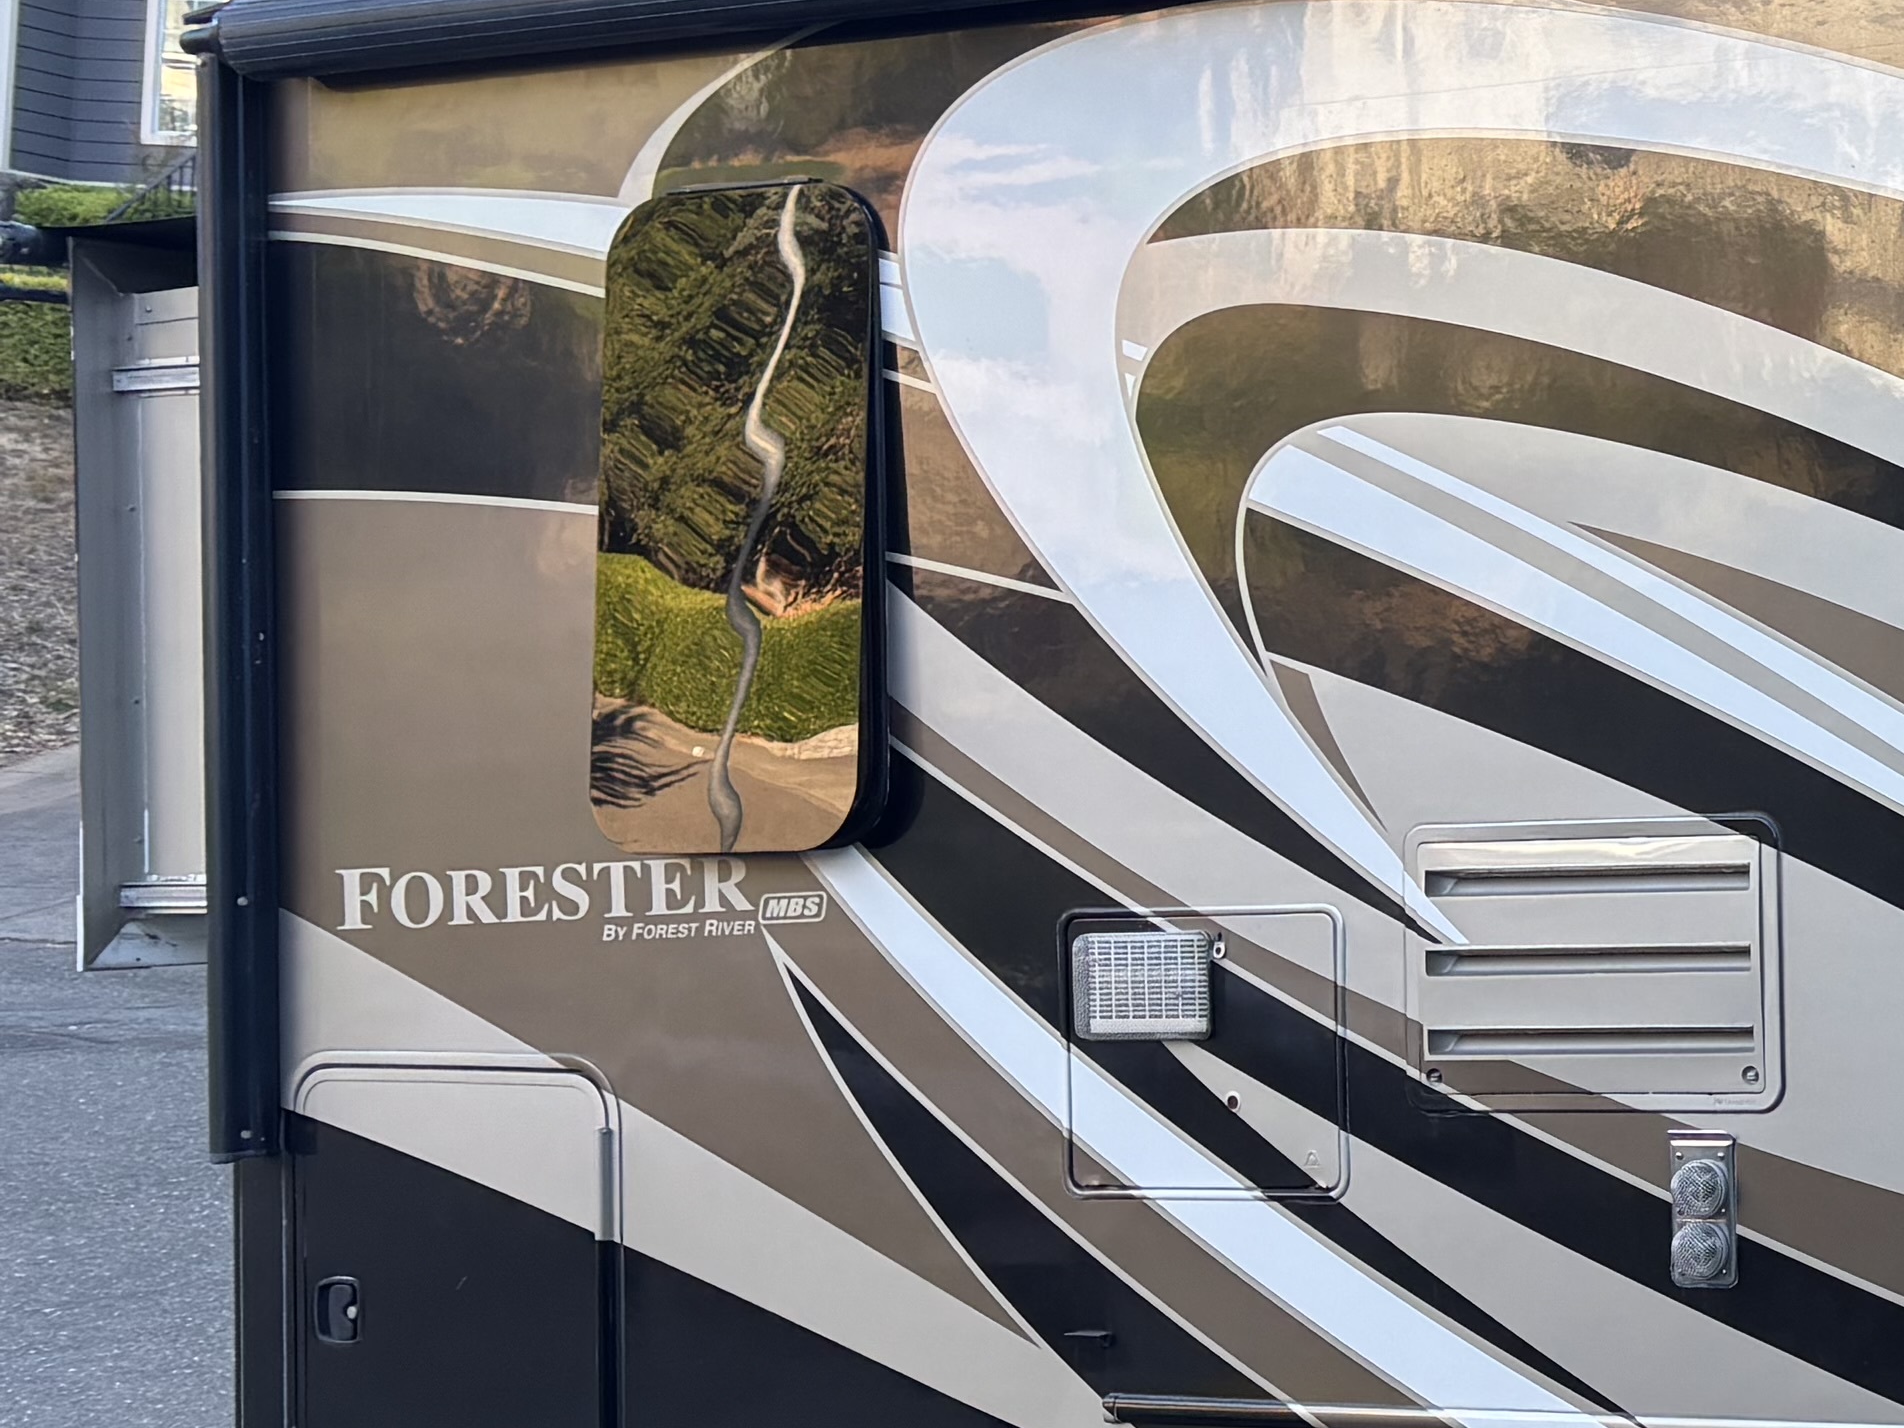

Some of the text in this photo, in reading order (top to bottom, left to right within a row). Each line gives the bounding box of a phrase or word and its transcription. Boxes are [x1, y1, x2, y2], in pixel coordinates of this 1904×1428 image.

[335, 858, 756, 930] FORESTER
[765, 897, 820, 918] MBS
[602, 919, 755, 941] BY FOREST RIVER
